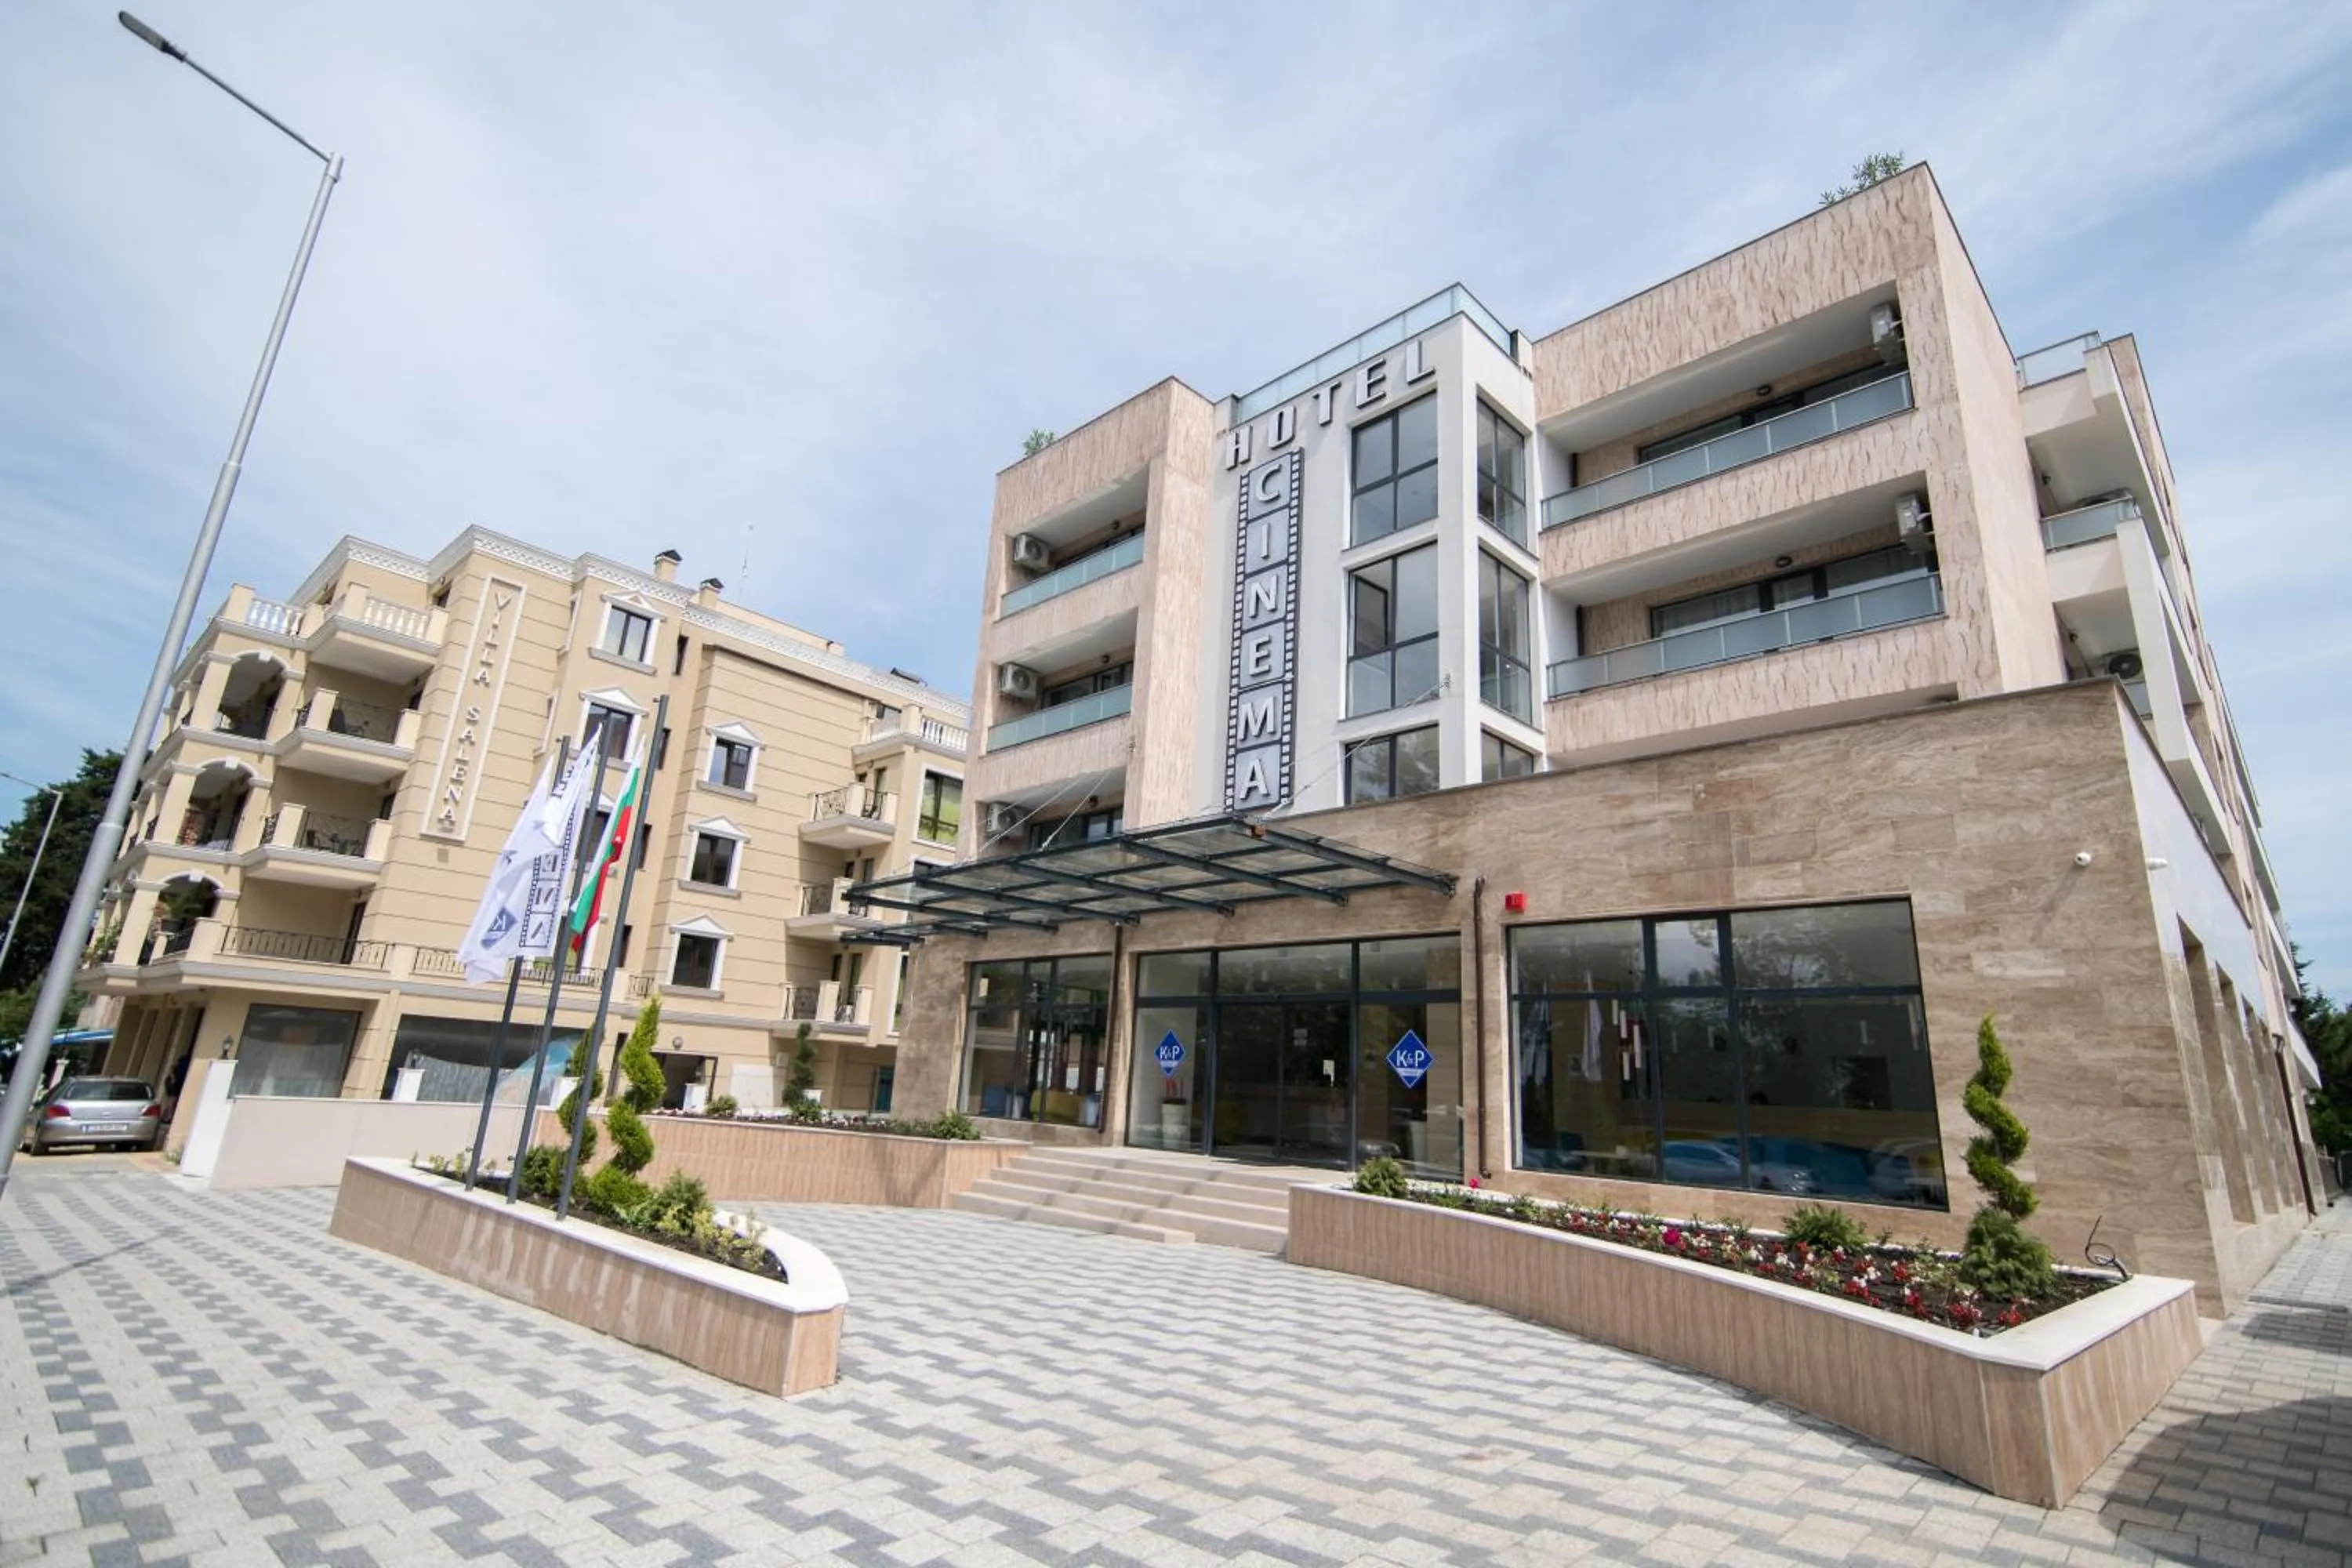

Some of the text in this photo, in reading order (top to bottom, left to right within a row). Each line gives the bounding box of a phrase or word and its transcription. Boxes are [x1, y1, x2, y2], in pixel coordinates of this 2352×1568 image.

[1225, 339, 1436, 470] HOTEL
[437, 591, 515, 827] VILLA SALENA
[1236, 463, 1283, 801] CINEMA
[1396, 1050, 1425, 1067] K&P
